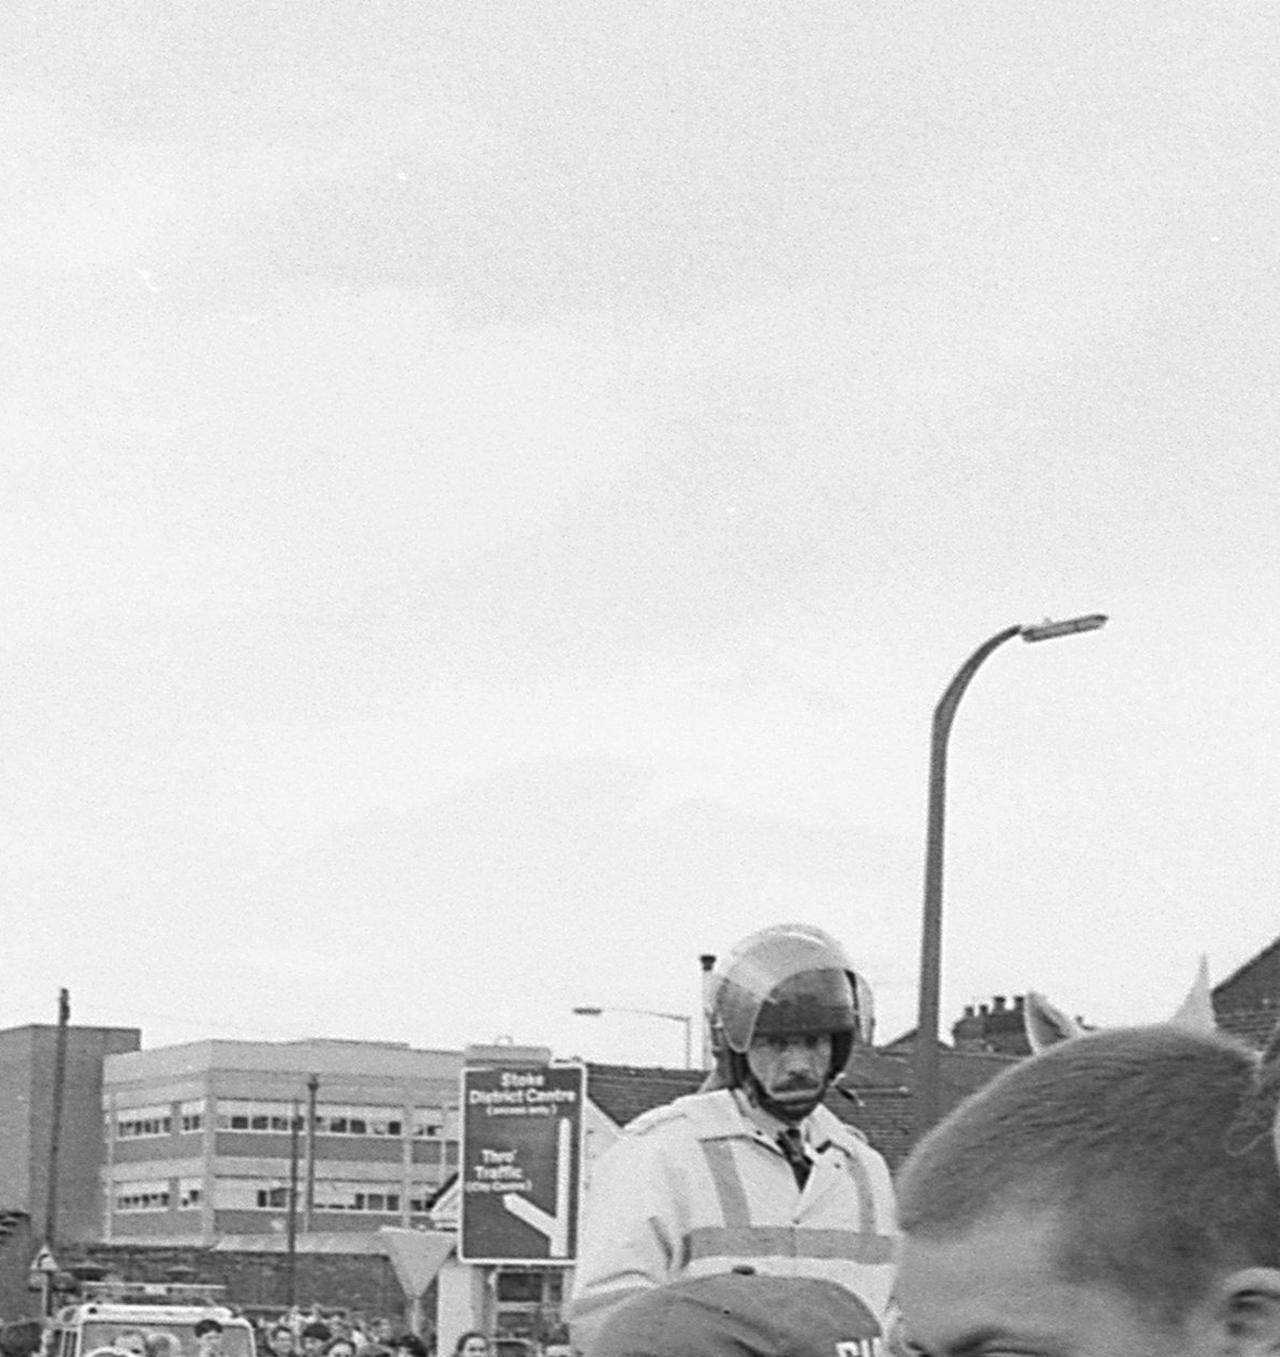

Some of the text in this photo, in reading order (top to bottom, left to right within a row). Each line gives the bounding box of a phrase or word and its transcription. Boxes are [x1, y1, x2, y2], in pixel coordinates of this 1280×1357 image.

[501, 1072, 544, 1087] Stoke
[469, 1087, 576, 1104] District Centre
[481, 1149, 518, 1163] Thro'
[473, 1163, 523, 1180] Traffic
